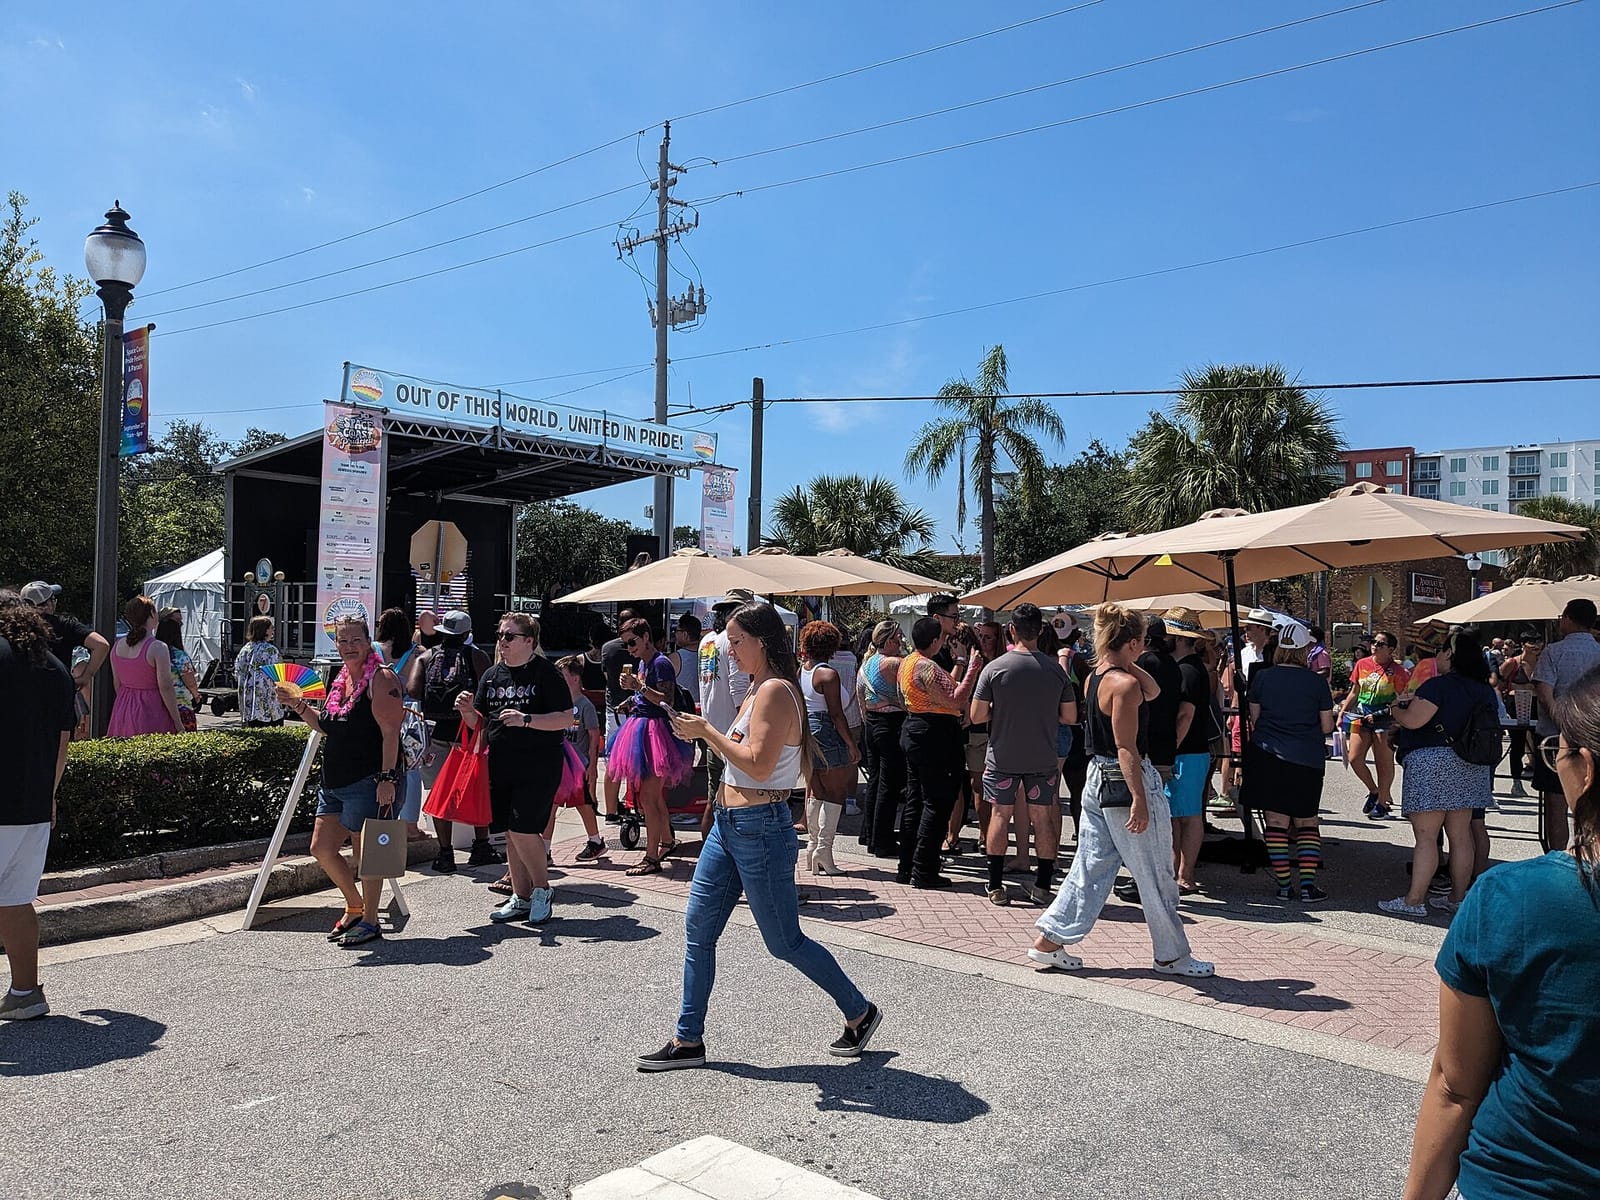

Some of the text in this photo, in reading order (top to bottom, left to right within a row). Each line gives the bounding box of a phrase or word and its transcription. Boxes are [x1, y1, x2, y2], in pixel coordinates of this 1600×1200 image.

[344, 416, 374, 431] SPACE
[396, 383, 432, 408] OUT
[437, 391, 460, 412] OF
[464, 395, 501, 418] THIS
[505, 402, 563, 432] WORLD,
[568, 414, 620, 438] UNITED
[623, 425, 636, 442] IN
[639, 428, 684, 450] PRIDE!
[343, 428, 373, 439] COAST
[260, 596, 267, 611] 7
